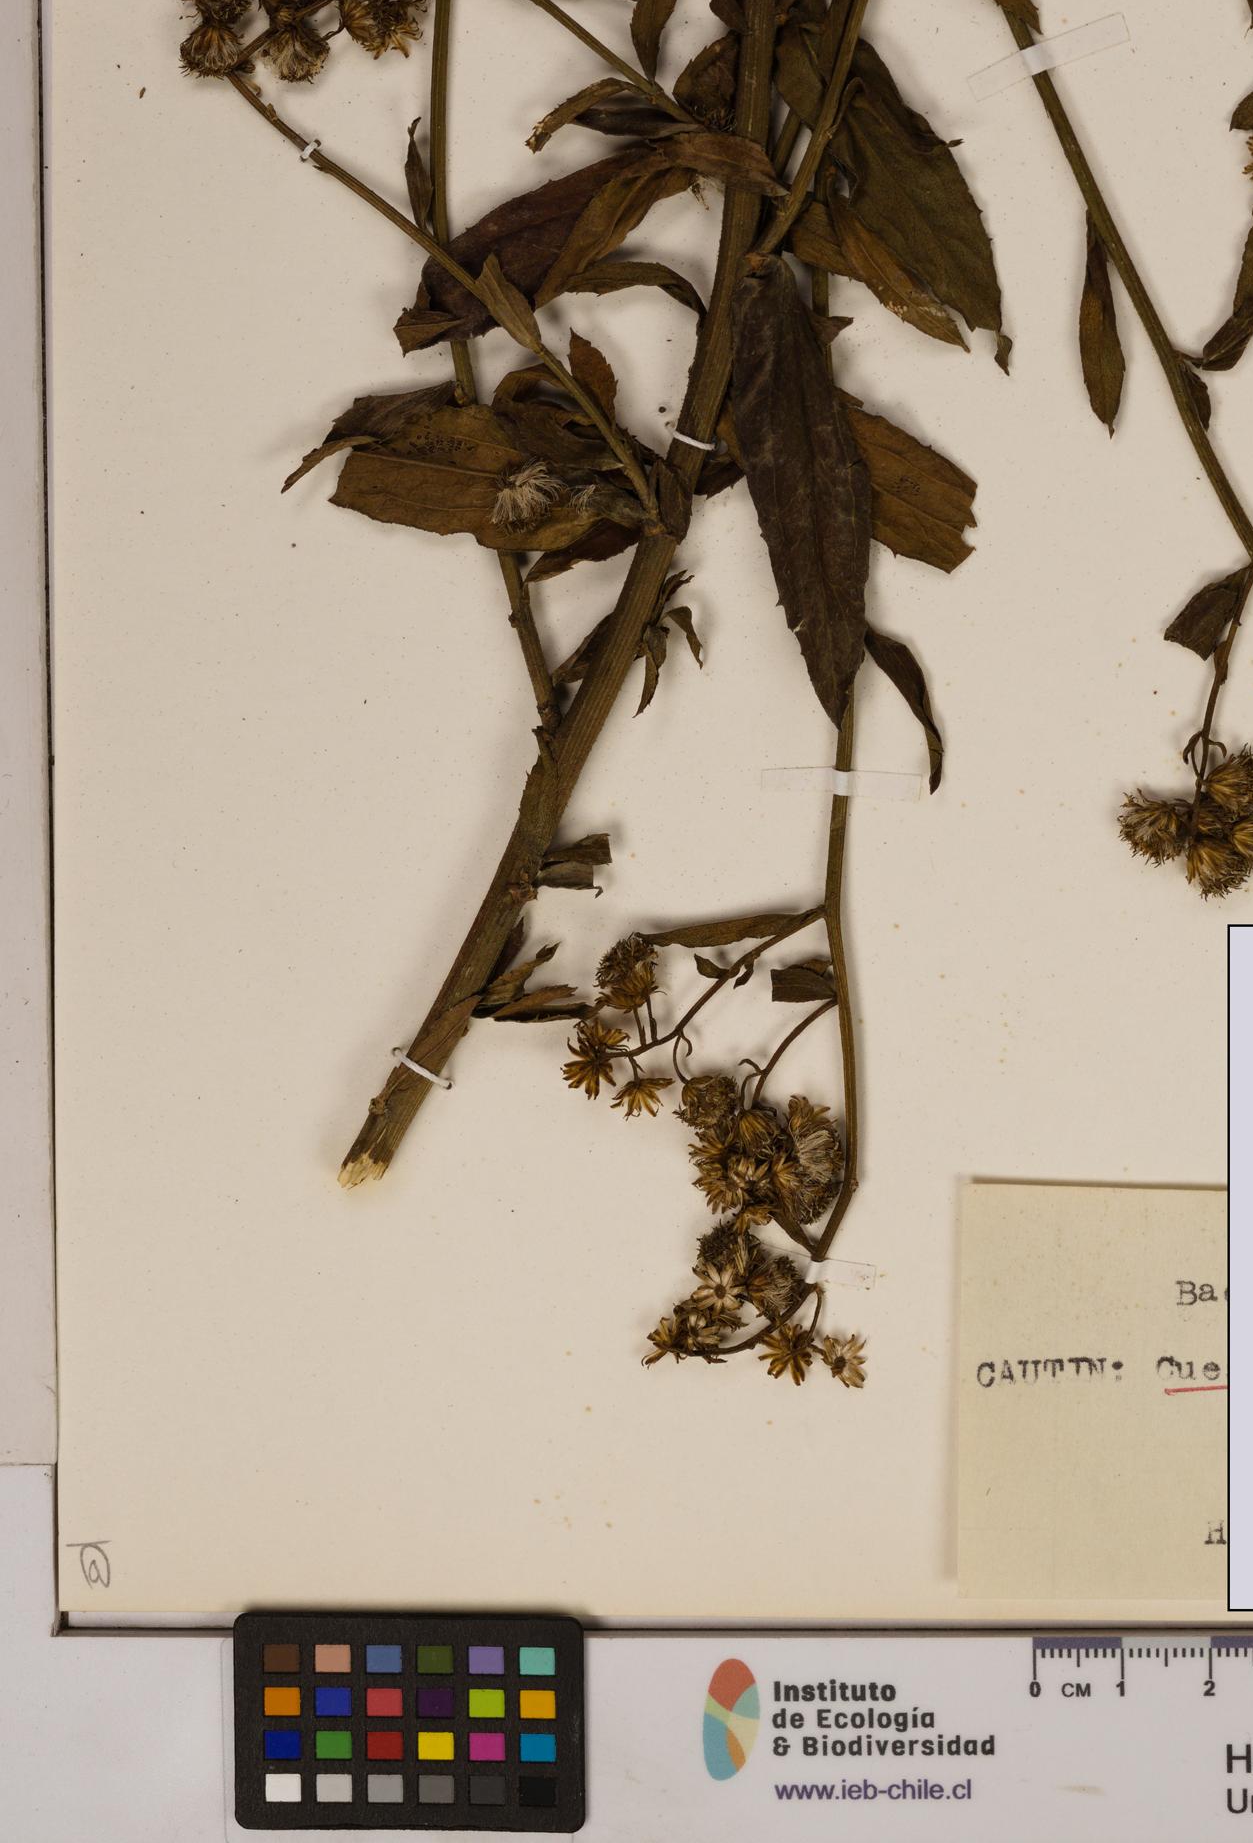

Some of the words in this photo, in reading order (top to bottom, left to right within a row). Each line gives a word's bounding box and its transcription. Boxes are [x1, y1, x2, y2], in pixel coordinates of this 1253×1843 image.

[1176, 1280, 1228, 1307] Ba
[1156, 1355, 1228, 1381] Cue
[773, 1678, 897, 1703] Instituto
[1028, 1681, 1042, 1698] 0
[1060, 1682, 1092, 1698] CM
[1115, 1681, 1126, 1697] 1
[1203, 1680, 1216, 1697] 2
[771, 1707, 805, 1730] de
[816, 1706, 936, 1733] Ecología
[772, 1736, 791, 1757] &
[802, 1733, 996, 1757] Biodiversidad
[774, 1778, 972, 1801] www.ieb-chile.cl
